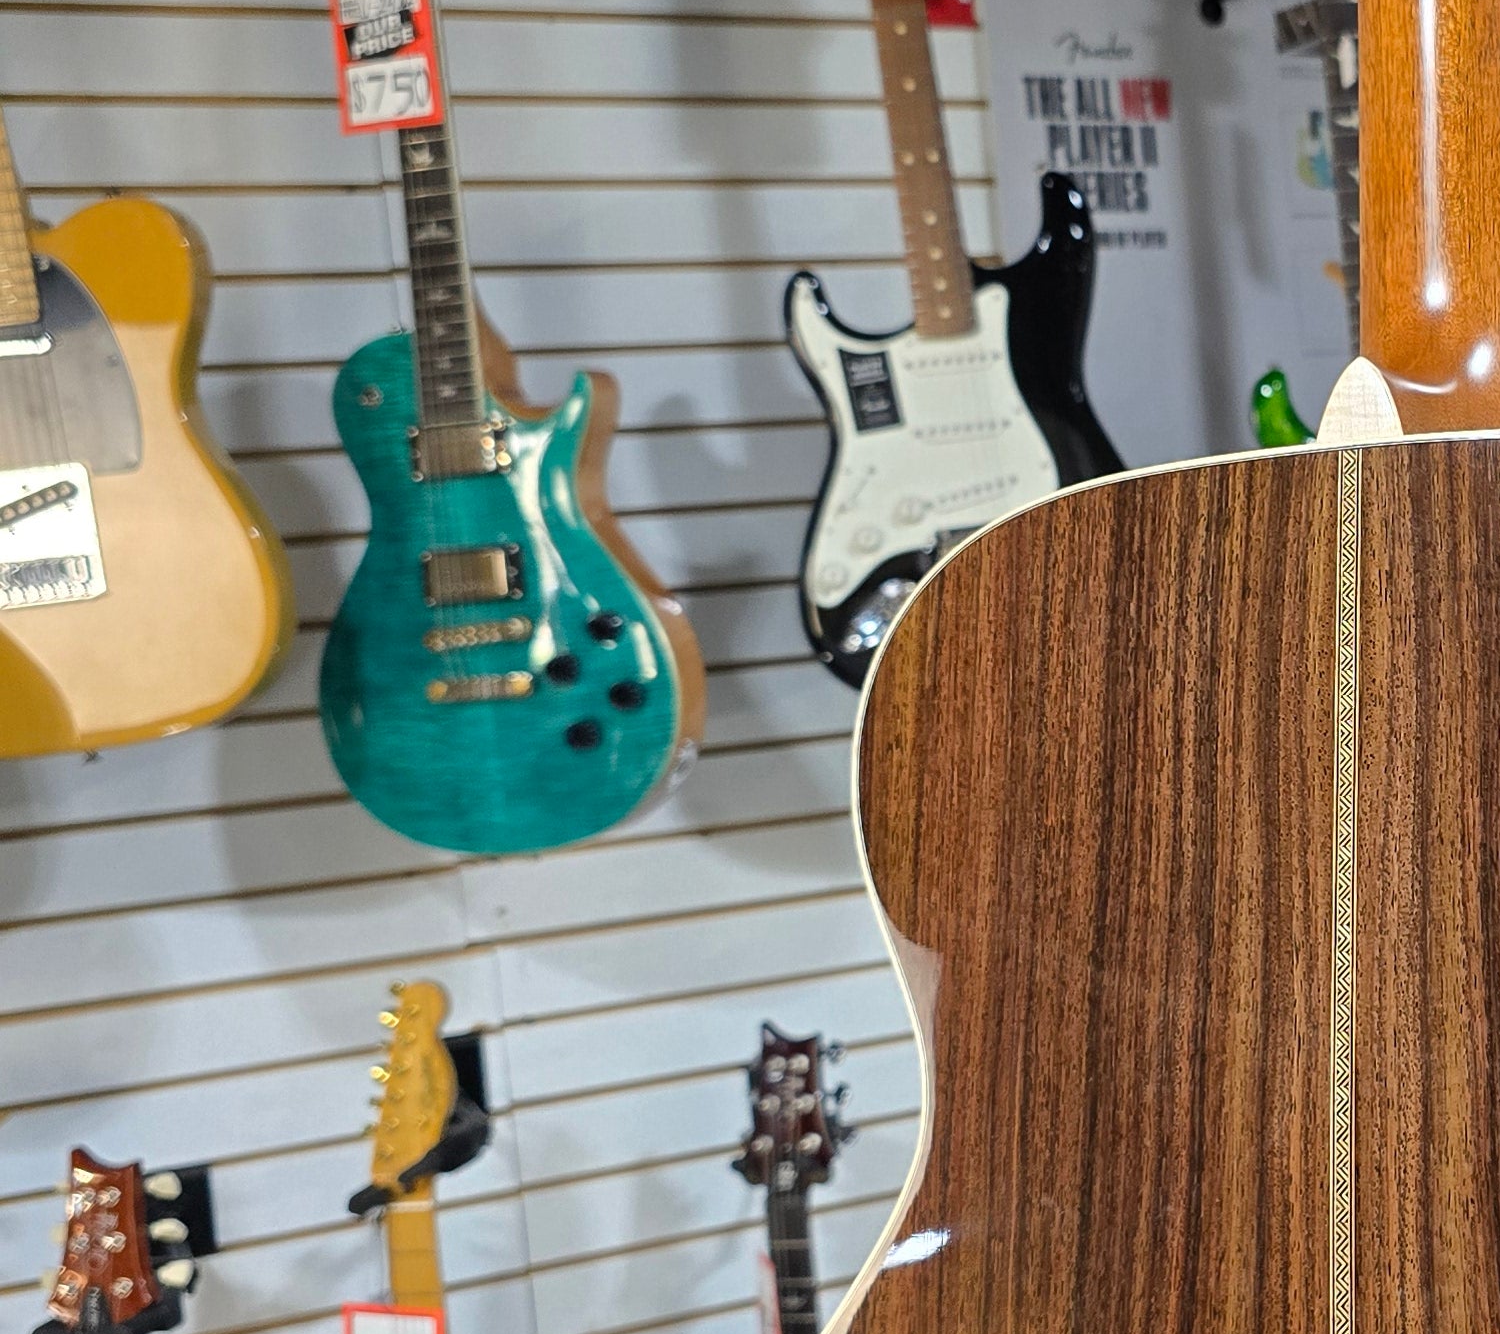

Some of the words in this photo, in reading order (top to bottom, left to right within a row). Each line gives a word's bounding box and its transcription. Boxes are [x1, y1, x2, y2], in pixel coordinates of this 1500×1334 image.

[351, 25, 415, 61] PRICE
[354, 12, 402, 40] OUR
[1023, 77, 1066, 120] THE
[1075, 77, 1115, 120] ALL
[1046, 124, 1134, 167] PLAYER
